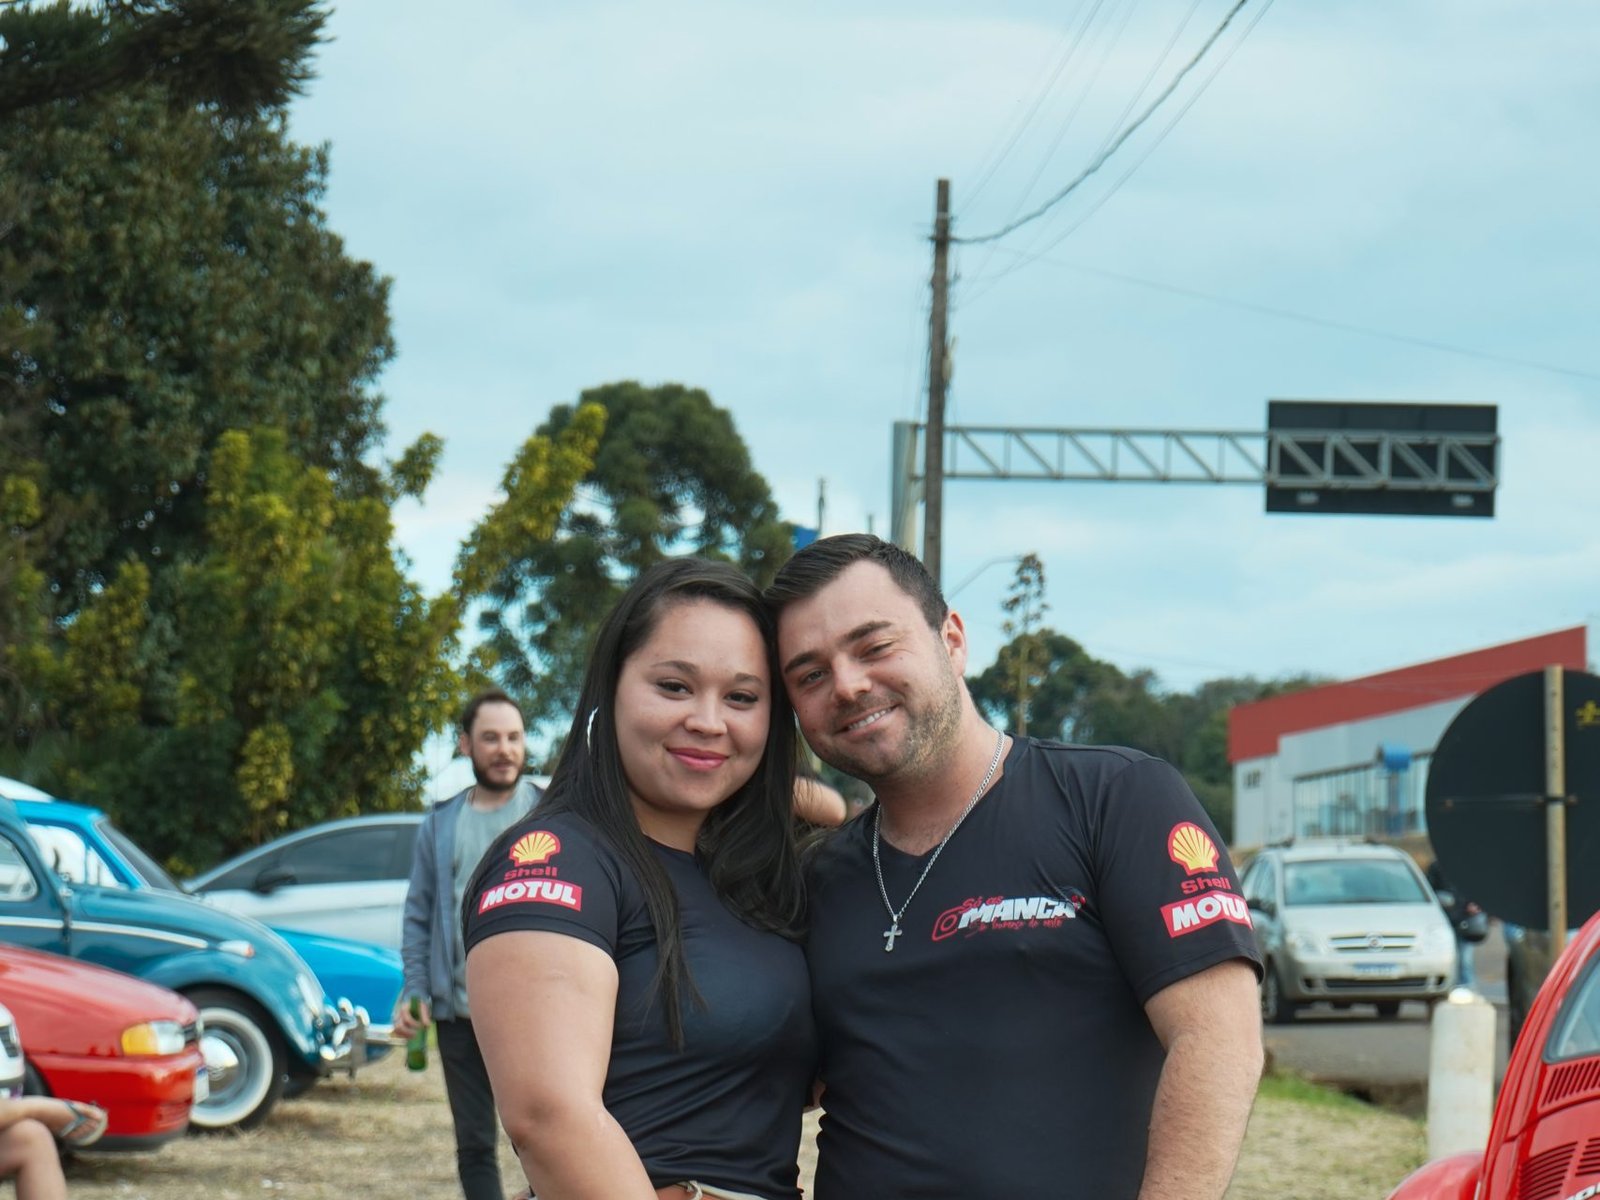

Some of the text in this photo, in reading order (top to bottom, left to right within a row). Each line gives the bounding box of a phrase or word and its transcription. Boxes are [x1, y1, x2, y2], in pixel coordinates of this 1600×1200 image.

[504, 866, 558, 881] Shell
[1181, 877, 1232, 895] Shell
[482, 881, 576, 910] MOTUL
